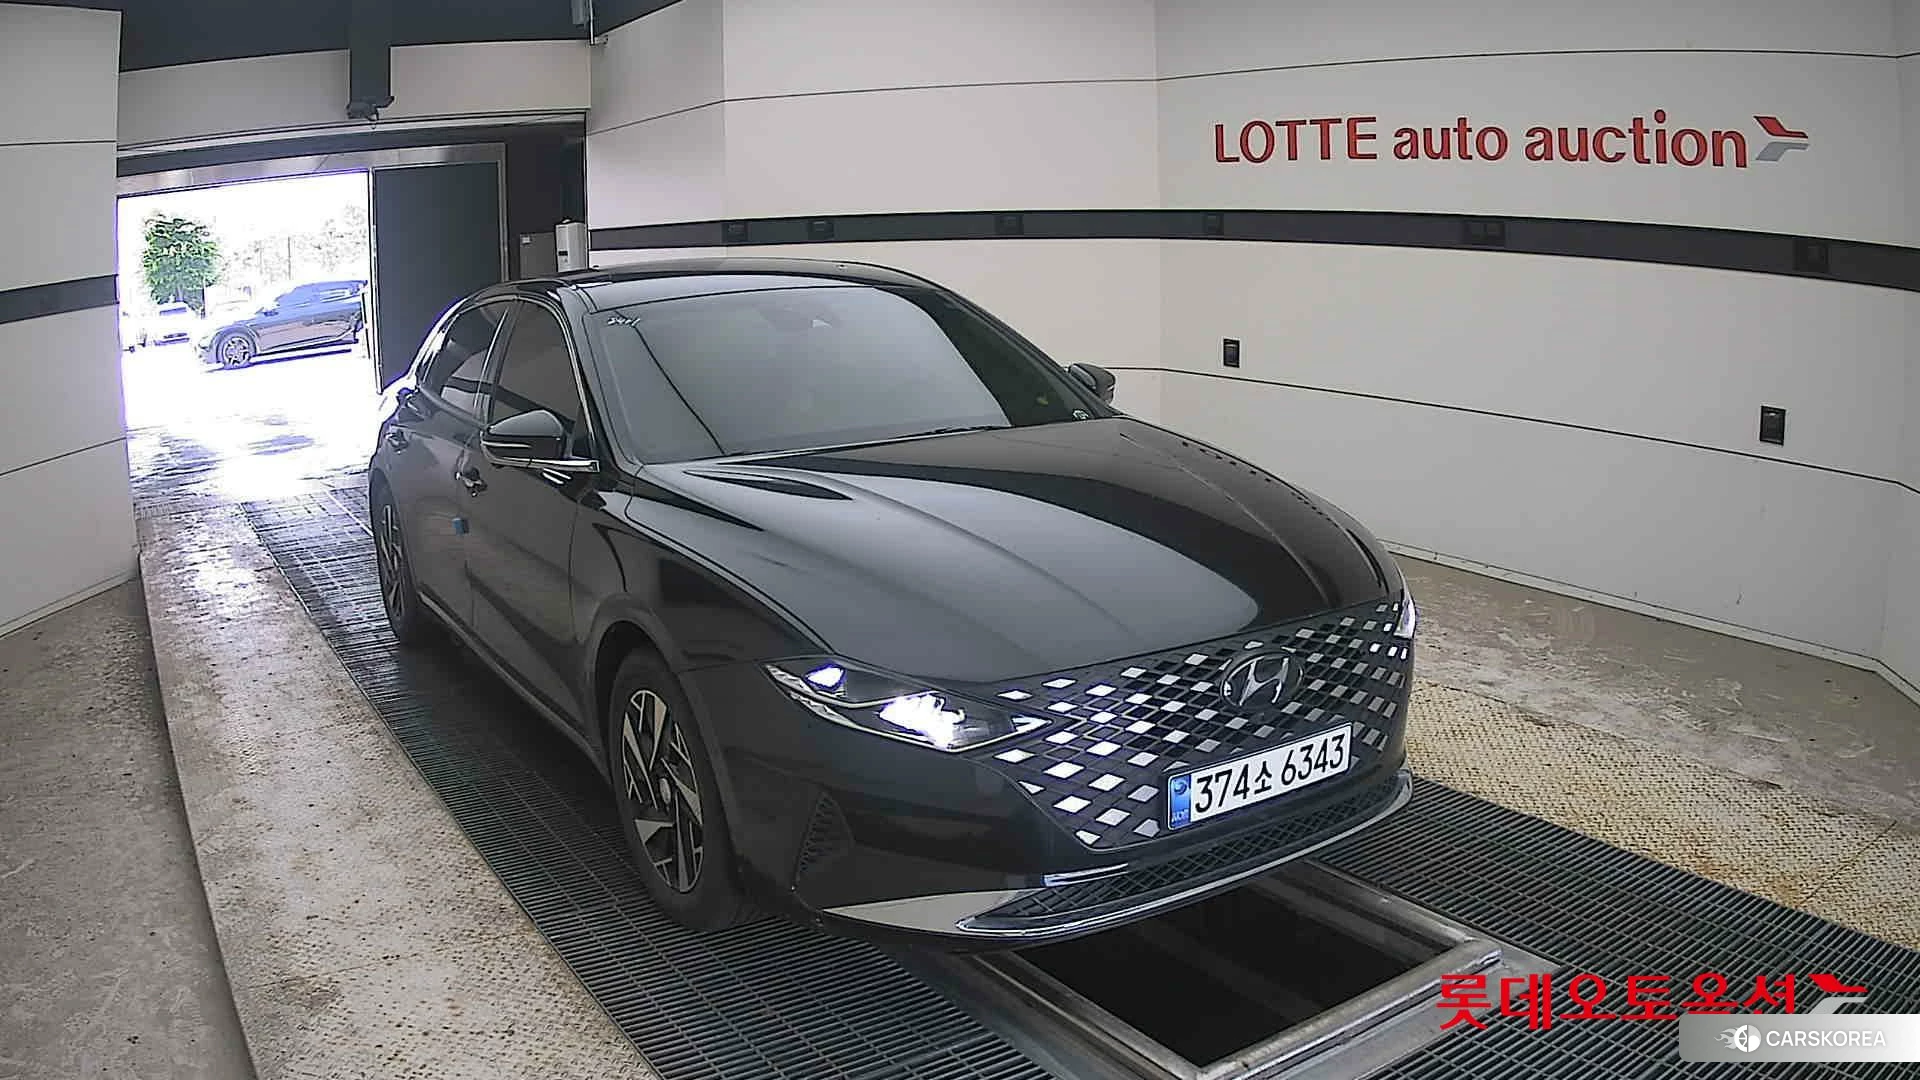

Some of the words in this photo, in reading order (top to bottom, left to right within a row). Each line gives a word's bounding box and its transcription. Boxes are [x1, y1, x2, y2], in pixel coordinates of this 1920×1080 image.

[1215, 116, 1377, 164] LOTTE
[1393, 117, 1508, 161] auto
[1524, 109, 1747, 169] auction
[1195, 760, 1273, 814] 374소
[1281, 733, 1345, 786] 6343
